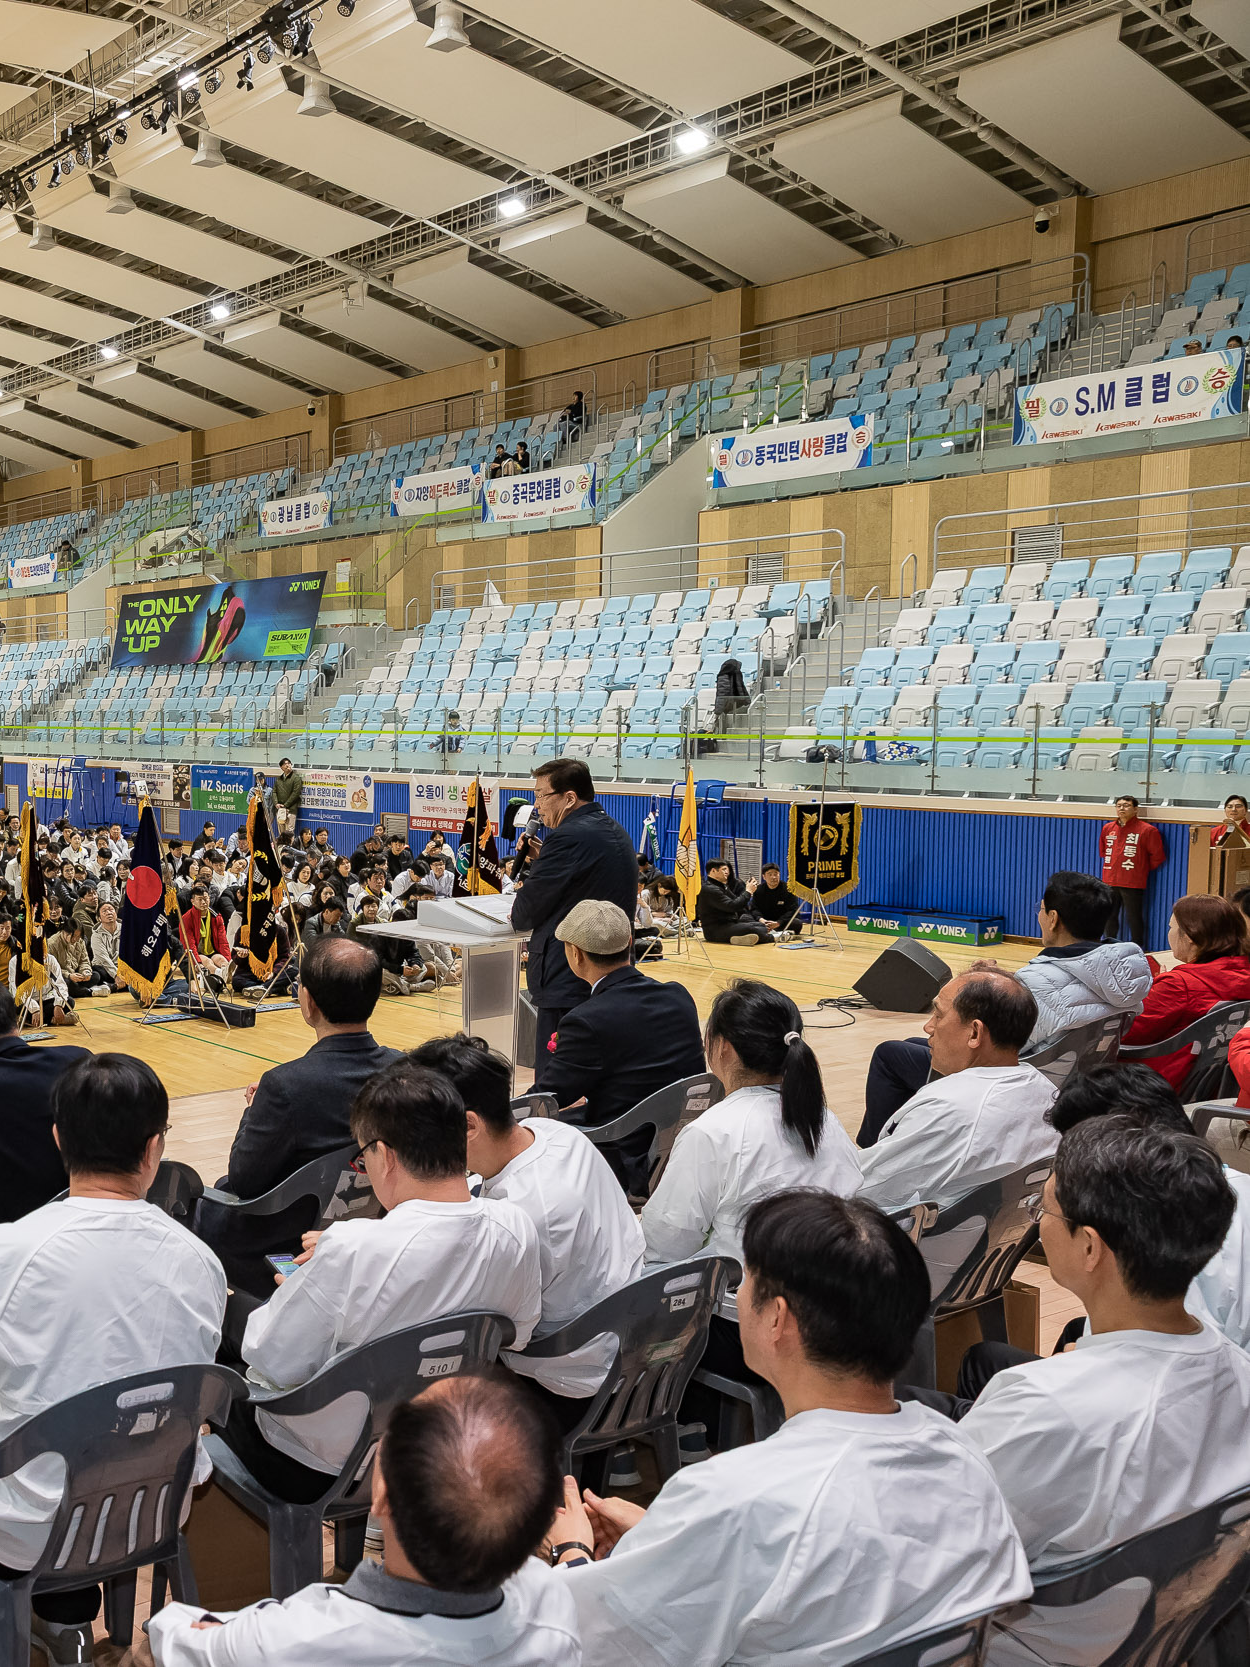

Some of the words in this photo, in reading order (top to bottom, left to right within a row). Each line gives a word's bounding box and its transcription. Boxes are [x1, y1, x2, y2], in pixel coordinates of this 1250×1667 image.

[1208, 368, 1231, 390] 승
[1074, 380, 1116, 417] S.M
[1124, 371, 1172, 408] 클럽
[1024, 398, 1040, 419] 필
[754, 431, 849, 467] 동국민턴사랑클럽
[512, 476, 561, 505] 중곡문화클럽
[278, 500, 311, 524] 광남클럽
[301, 579, 321, 591] YONEX
[138, 594, 202, 617] ONLY
[125, 616, 178, 636] WAY
[128, 635, 161, 654] UP
[200, 780, 213, 792] MZ
[215, 780, 244, 795] Sports
[415, 784, 444, 800] 오돌이
[447, 785, 458, 801] 생
[1122, 832, 1140, 871] 최동수
[808, 860, 843, 872] PRIME
[872, 918, 900, 930] YONEX
[936, 924, 967, 938] YONEX
[672, 1298, 686, 1308] 284
[428, 1363, 448, 1375] 510
